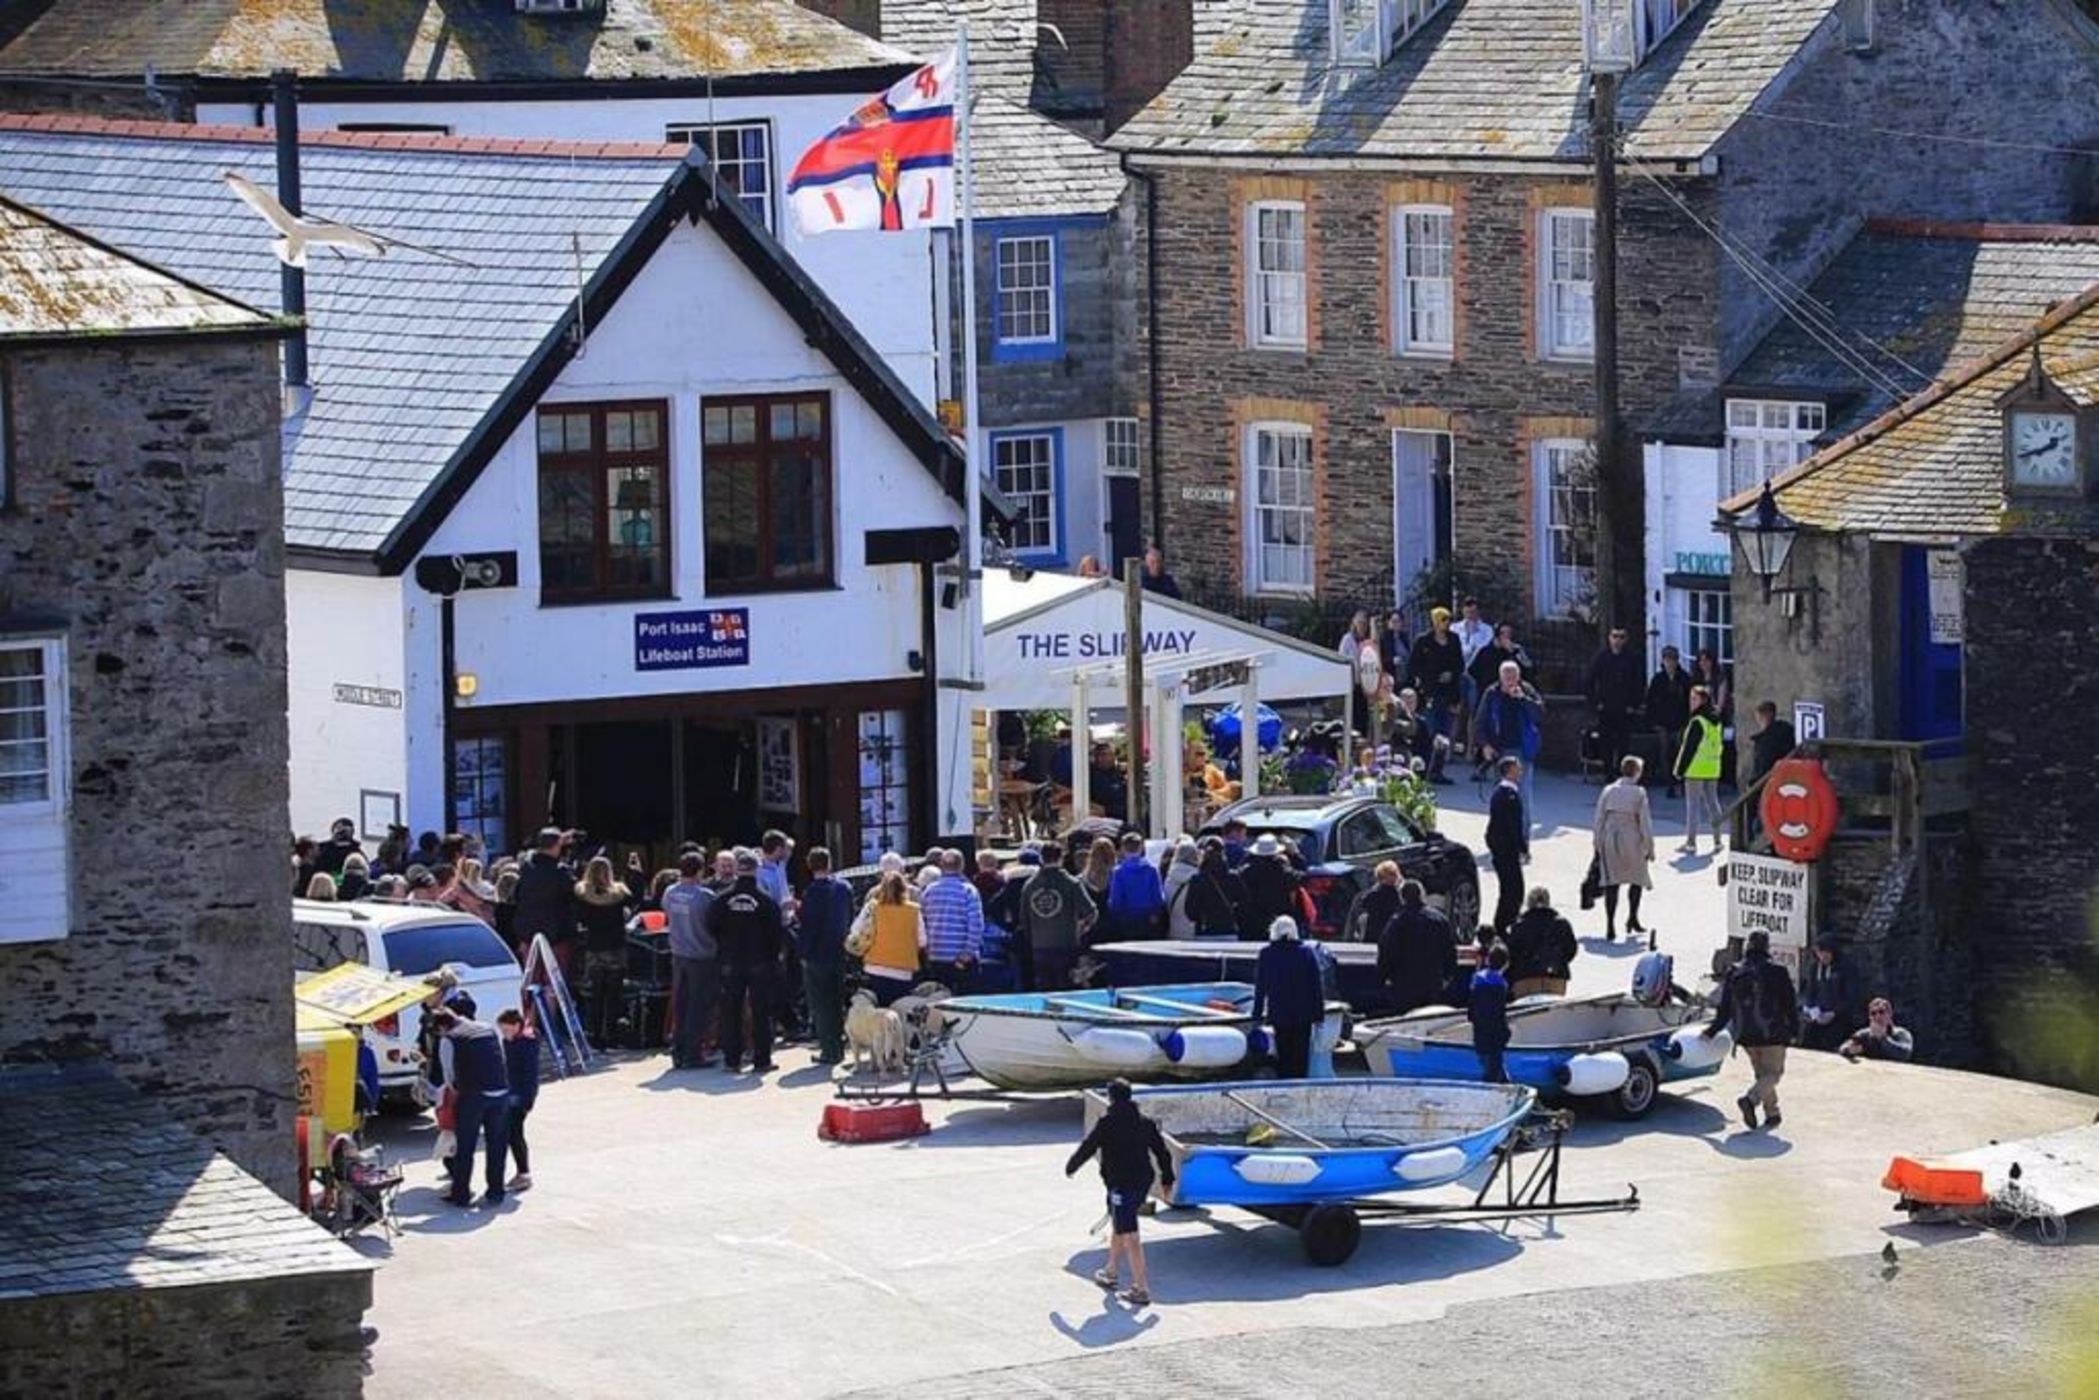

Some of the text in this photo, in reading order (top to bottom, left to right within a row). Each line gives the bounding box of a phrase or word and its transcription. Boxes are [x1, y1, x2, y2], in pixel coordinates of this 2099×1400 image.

[639, 622, 667, 636] Port
[670, 621, 706, 634] Isaac
[639, 645, 744, 663] Lifeboat Station
[1017, 633, 1070, 658] THE
[1804, 715, 1817, 738] P
[1758, 866, 1804, 888] SLIPWAY
[1738, 886, 1794, 912] CLEAR FOR
